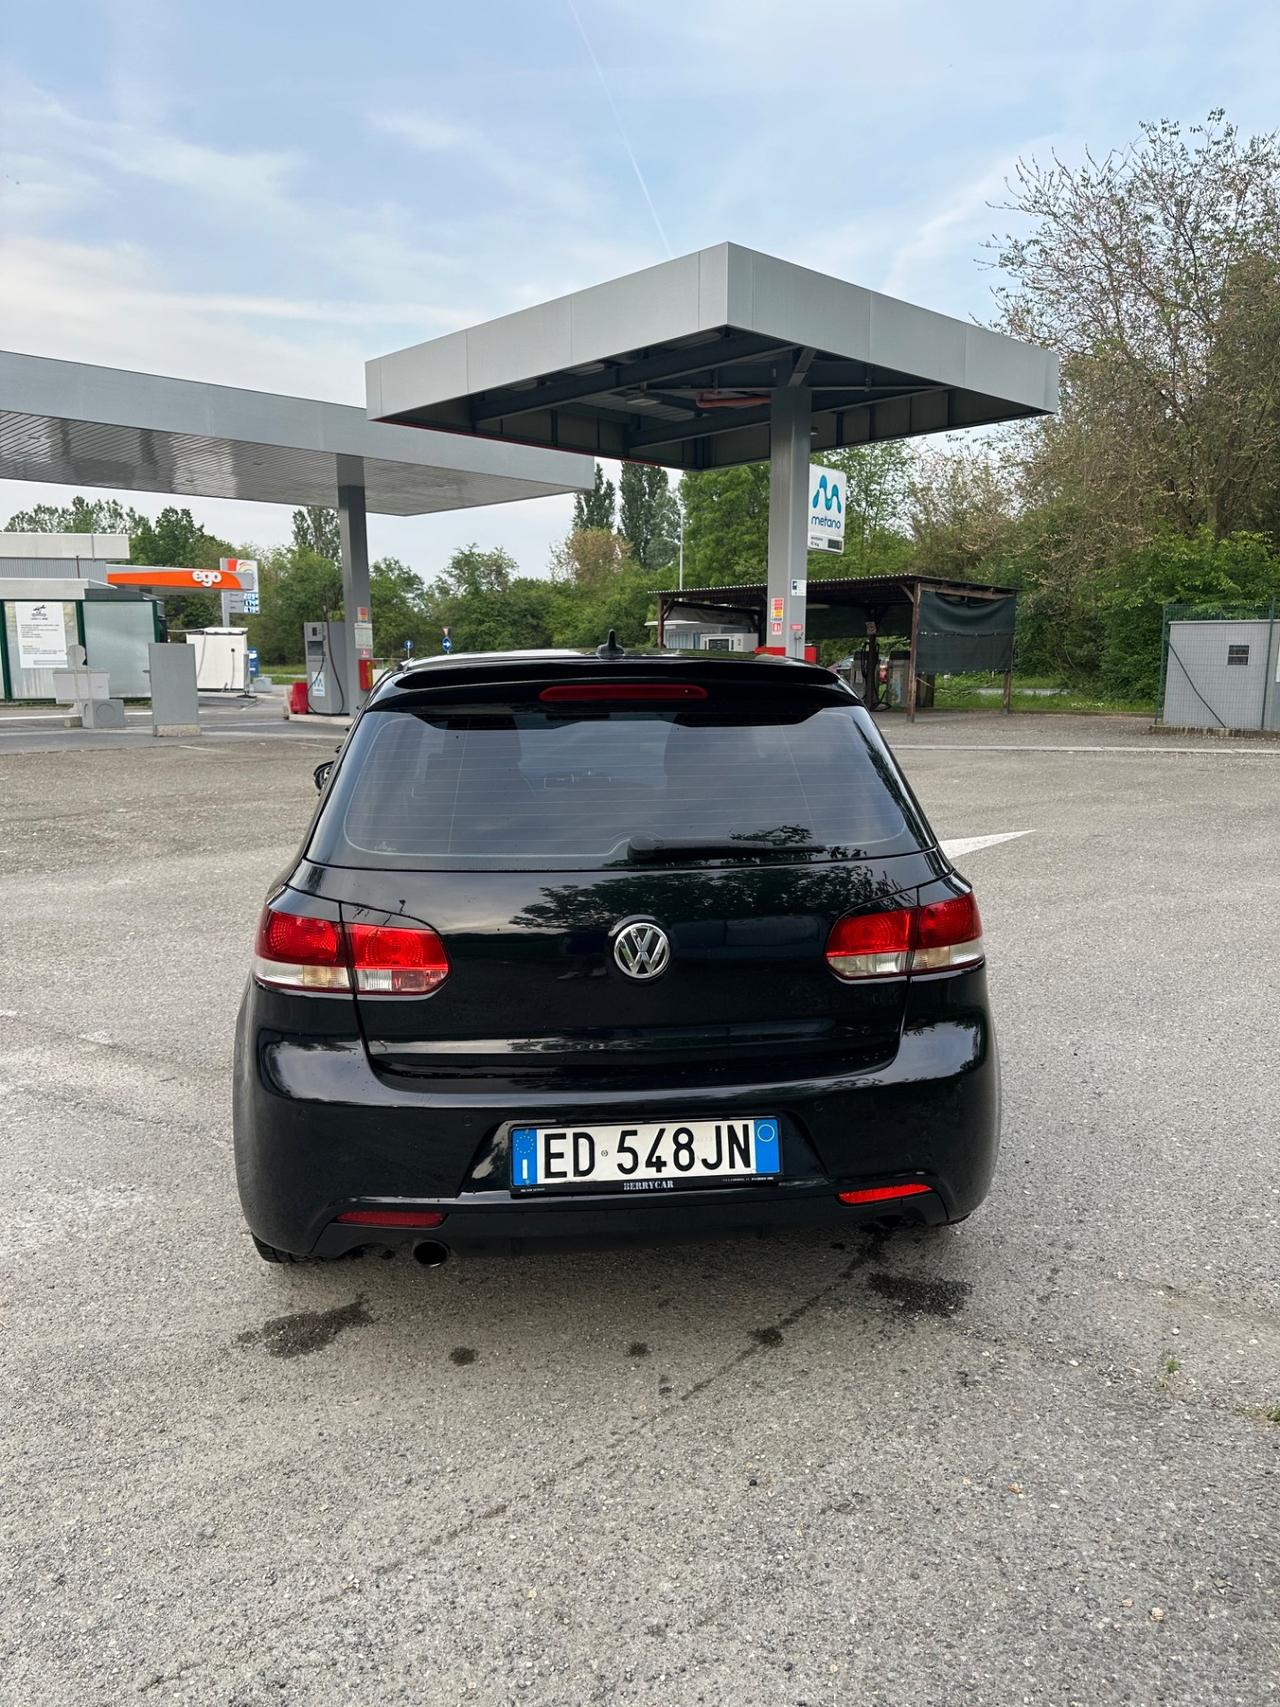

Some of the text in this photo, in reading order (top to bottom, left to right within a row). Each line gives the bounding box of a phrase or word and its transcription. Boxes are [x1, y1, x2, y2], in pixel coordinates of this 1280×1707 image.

[810, 516, 842, 530] metano
[192, 570, 222, 588] ego
[543, 1123, 752, 1179] ED 548JN
[623, 1179, 675, 1191] BERRYCAR
